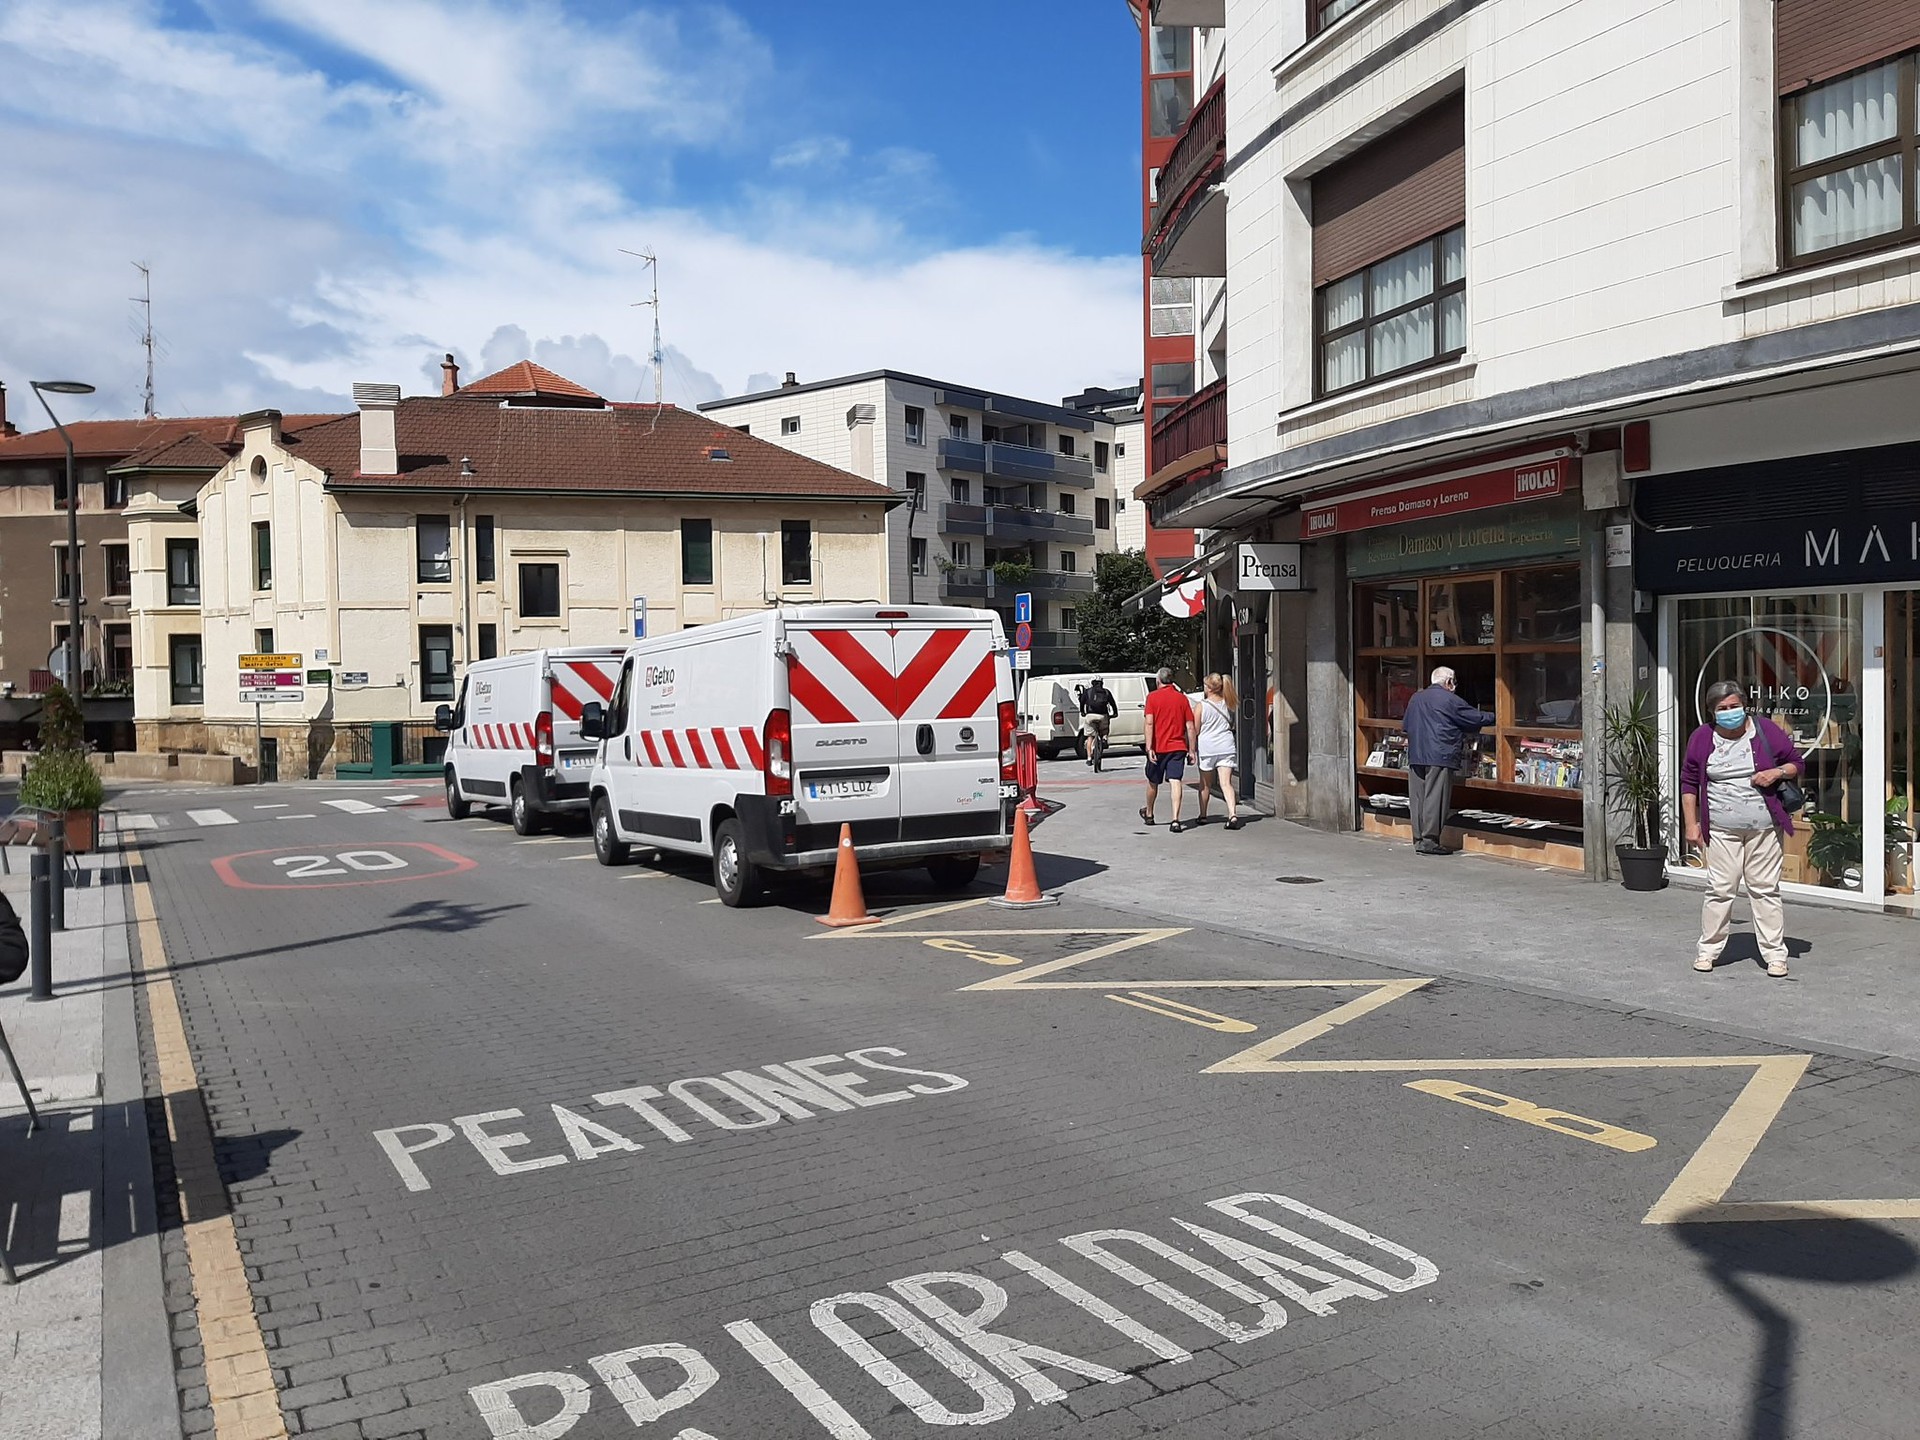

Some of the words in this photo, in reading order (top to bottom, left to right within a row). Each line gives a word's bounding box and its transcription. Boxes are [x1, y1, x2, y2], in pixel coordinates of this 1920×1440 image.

[1517, 468, 1555, 492] ¡HOLA!
[1370, 502, 1397, 517] Prensa
[1433, 496, 1438, 508] y
[1440, 490, 1469, 504] Lorena
[1309, 510, 1335, 532] ¡HOLA!
[1459, 525, 1505, 548] Lorena
[1242, 555, 1297, 577] Prensa
[1676, 552, 1781, 573] PELUQUERIA
[653, 666, 675, 686] Getxo
[1773, 707, 1810, 715] BELLEZA
[815, 738, 868, 747] DUCATO
[820, 782, 849, 795] 4115
[852, 780, 873, 793] LDZ
[272, 850, 409, 878] 20
[373, 1046, 970, 1193] PEATONES
